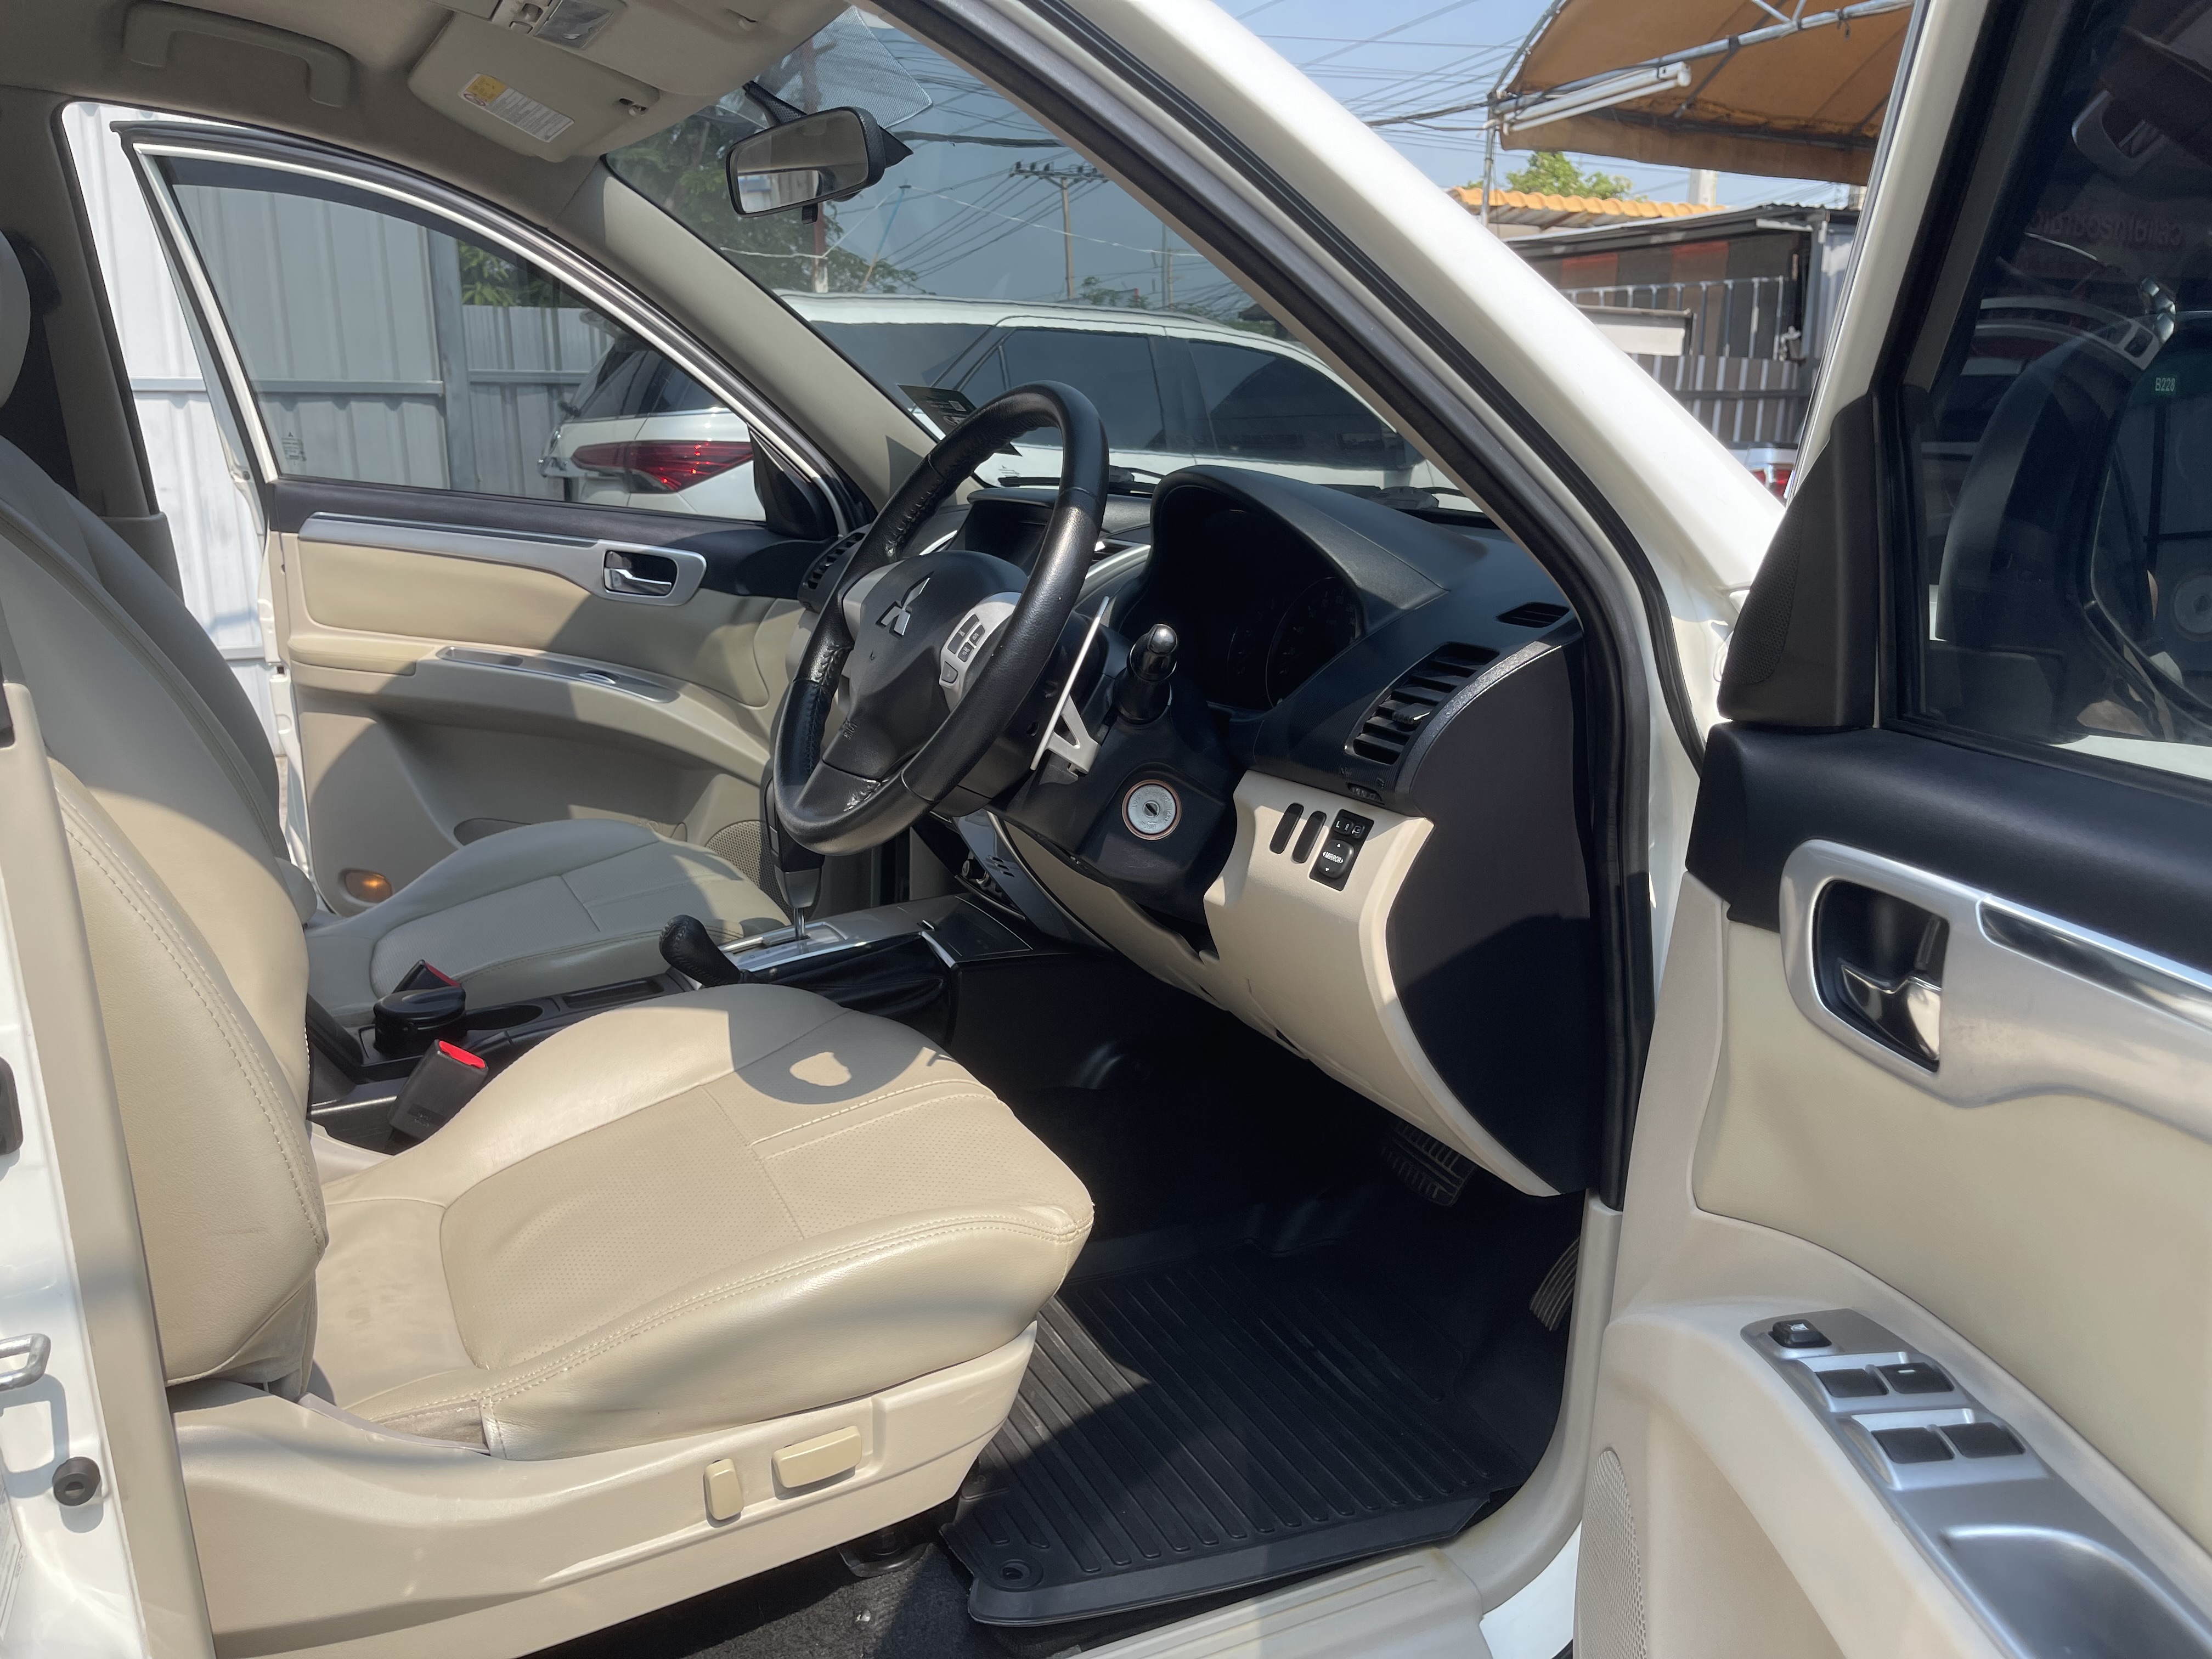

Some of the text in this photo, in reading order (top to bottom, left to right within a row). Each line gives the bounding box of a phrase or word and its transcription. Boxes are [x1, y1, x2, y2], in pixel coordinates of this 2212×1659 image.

[2155, 377, 2175, 392] B228
[1132, 793, 1142, 808] LOCK
[1325, 851, 1341, 863] MIRROR
